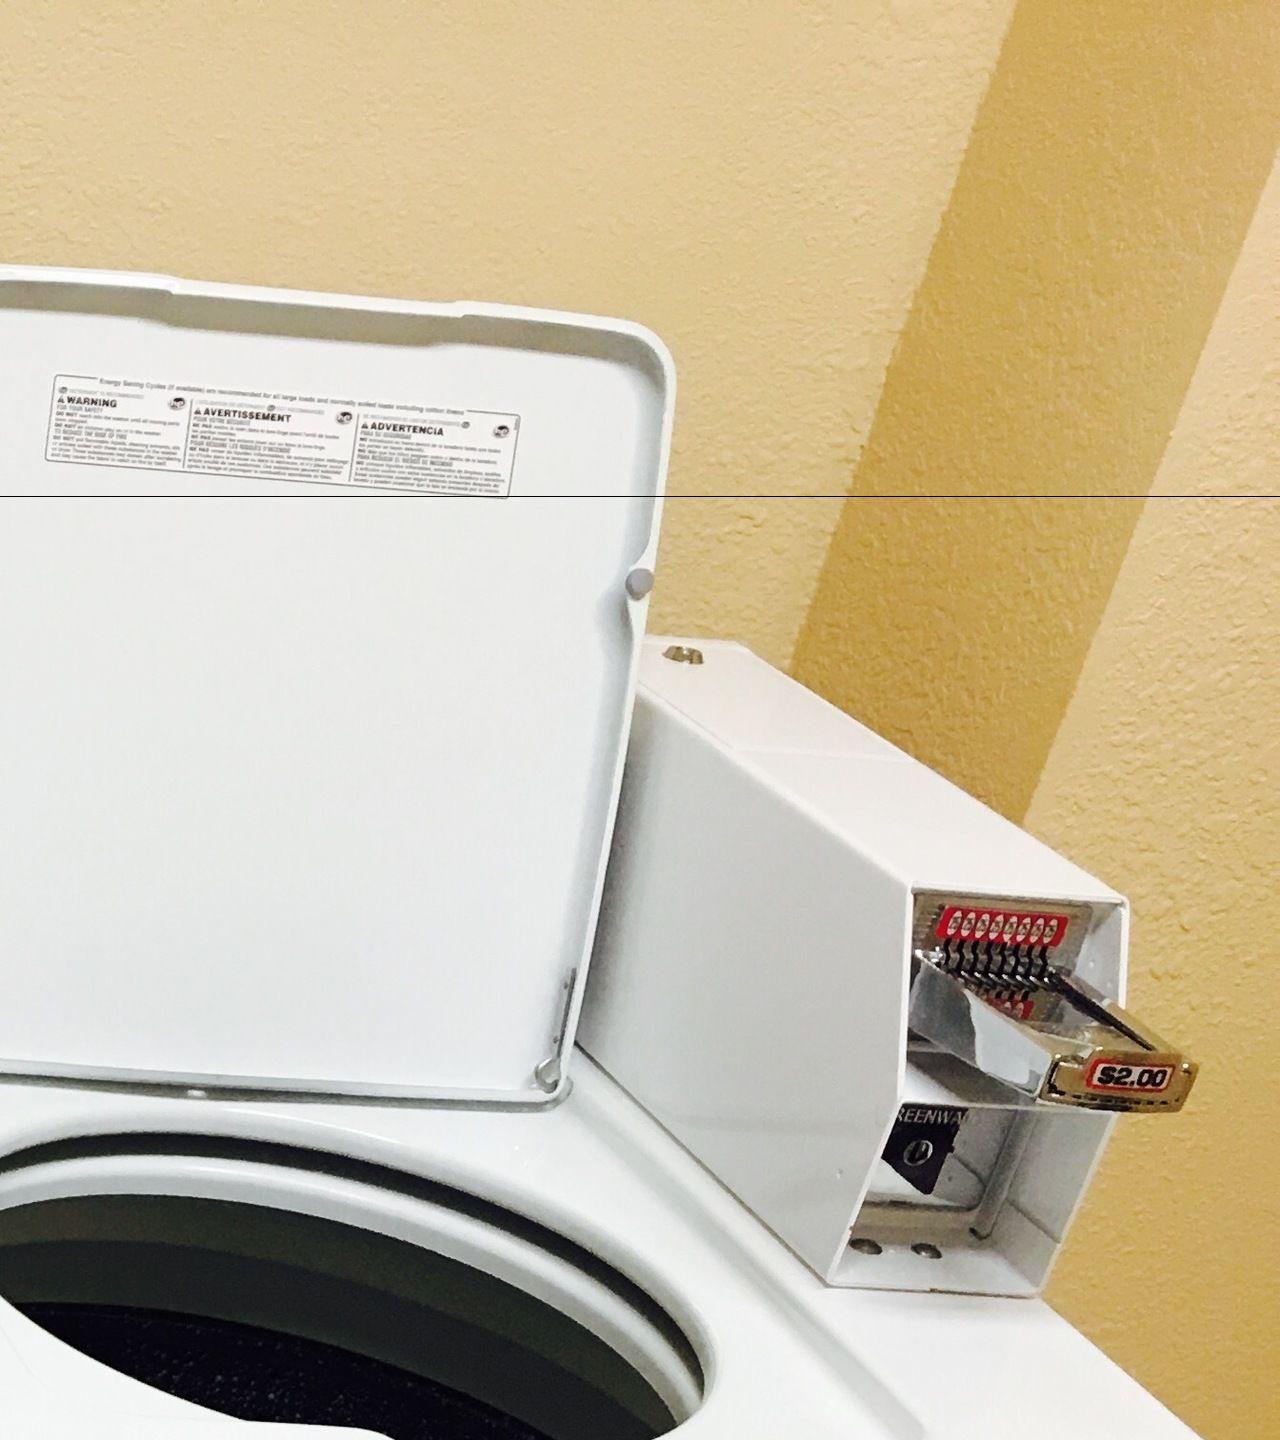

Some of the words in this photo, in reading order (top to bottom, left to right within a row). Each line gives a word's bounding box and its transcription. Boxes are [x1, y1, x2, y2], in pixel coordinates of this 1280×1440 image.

[66, 396, 118, 408] WARNING
[203, 407, 292, 423] AVERTISSEMENT
[370, 422, 444, 436] ADVERTENCIA
[1097, 1065, 1168, 1087] $2.00
